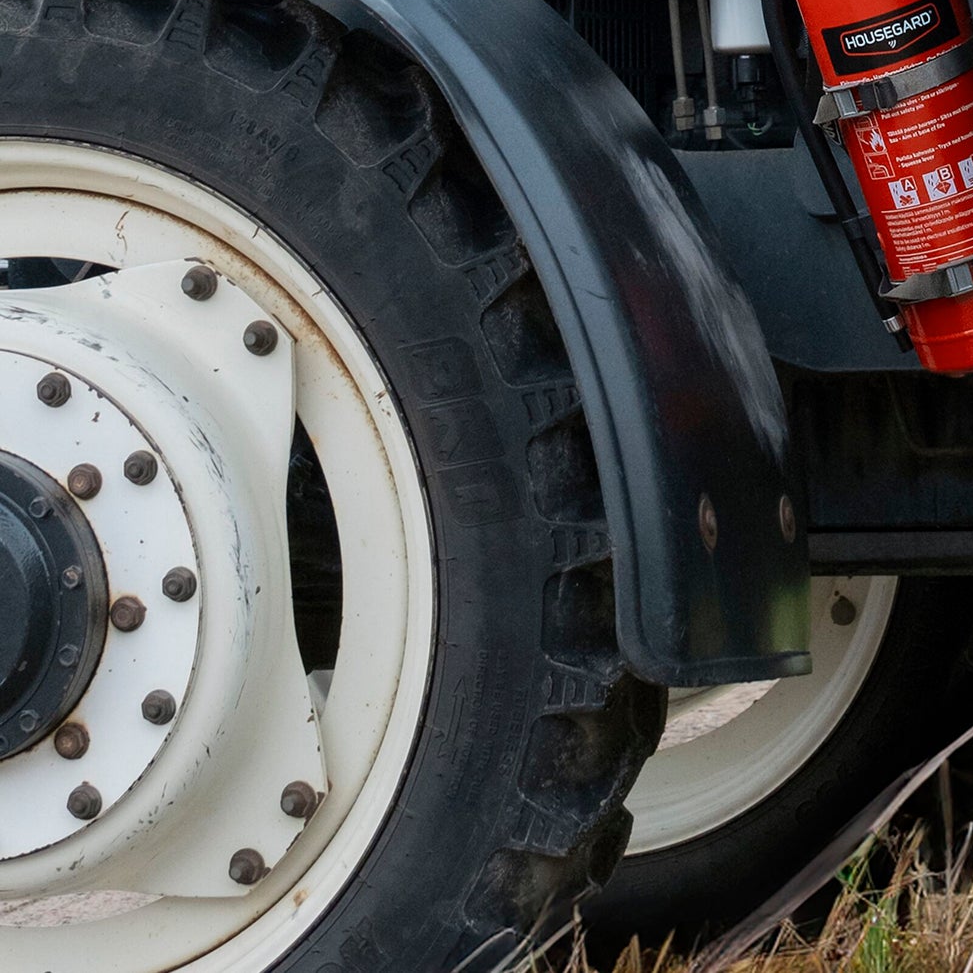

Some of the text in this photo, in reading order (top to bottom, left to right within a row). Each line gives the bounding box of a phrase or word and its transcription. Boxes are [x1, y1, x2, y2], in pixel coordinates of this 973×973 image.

[844, 11, 931, 50] HOUSEGARD
[903, 179, 915, 191] A
[940, 168, 951, 180] B
